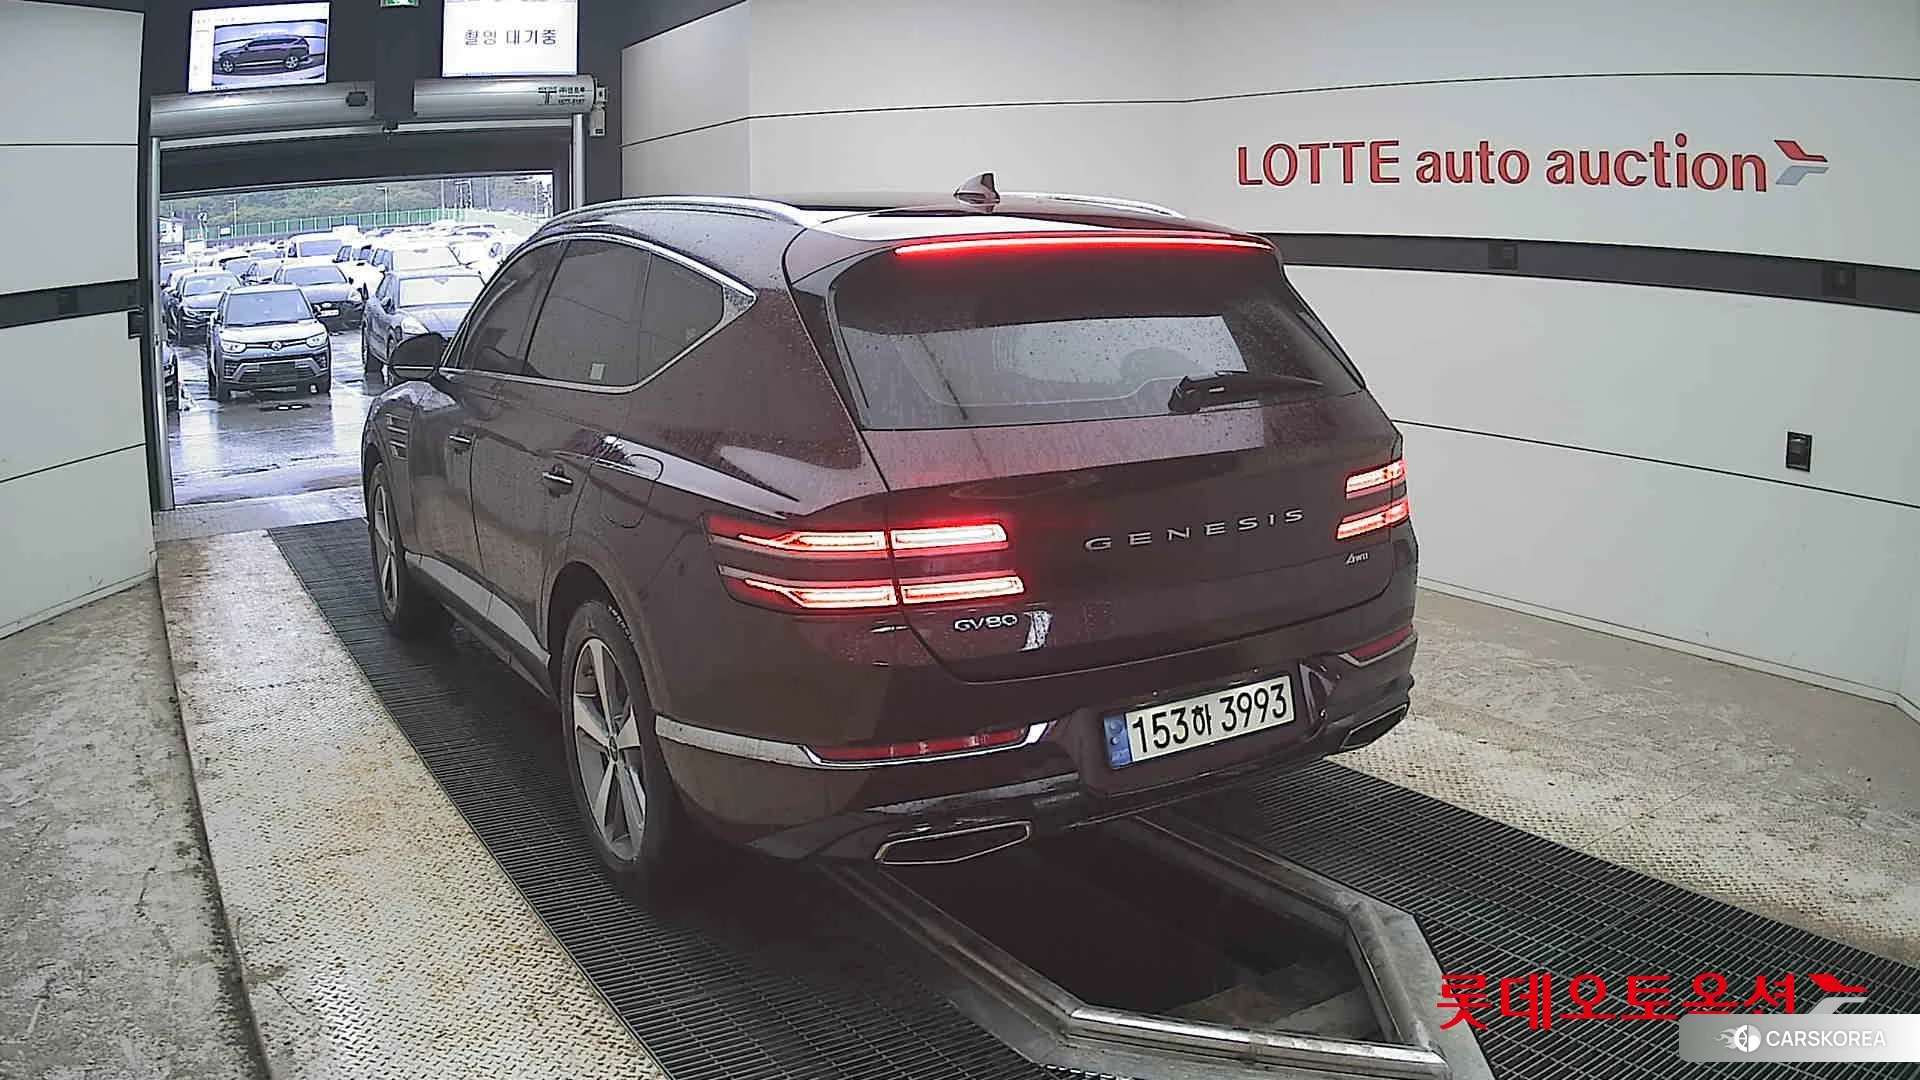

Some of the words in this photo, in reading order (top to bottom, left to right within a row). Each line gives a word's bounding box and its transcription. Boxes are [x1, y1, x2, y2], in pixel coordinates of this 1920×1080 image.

[506, 29, 557, 46] 대기중
[1237, 140, 1400, 186] LOTTE
[1415, 140, 1531, 185] auto
[1546, 132, 1769, 193] auction
[1085, 509, 1304, 551] GENESIS
[954, 614, 1019, 631] GV80
[1132, 703, 1212, 753] 153하
[1219, 683, 1287, 732] 3993
